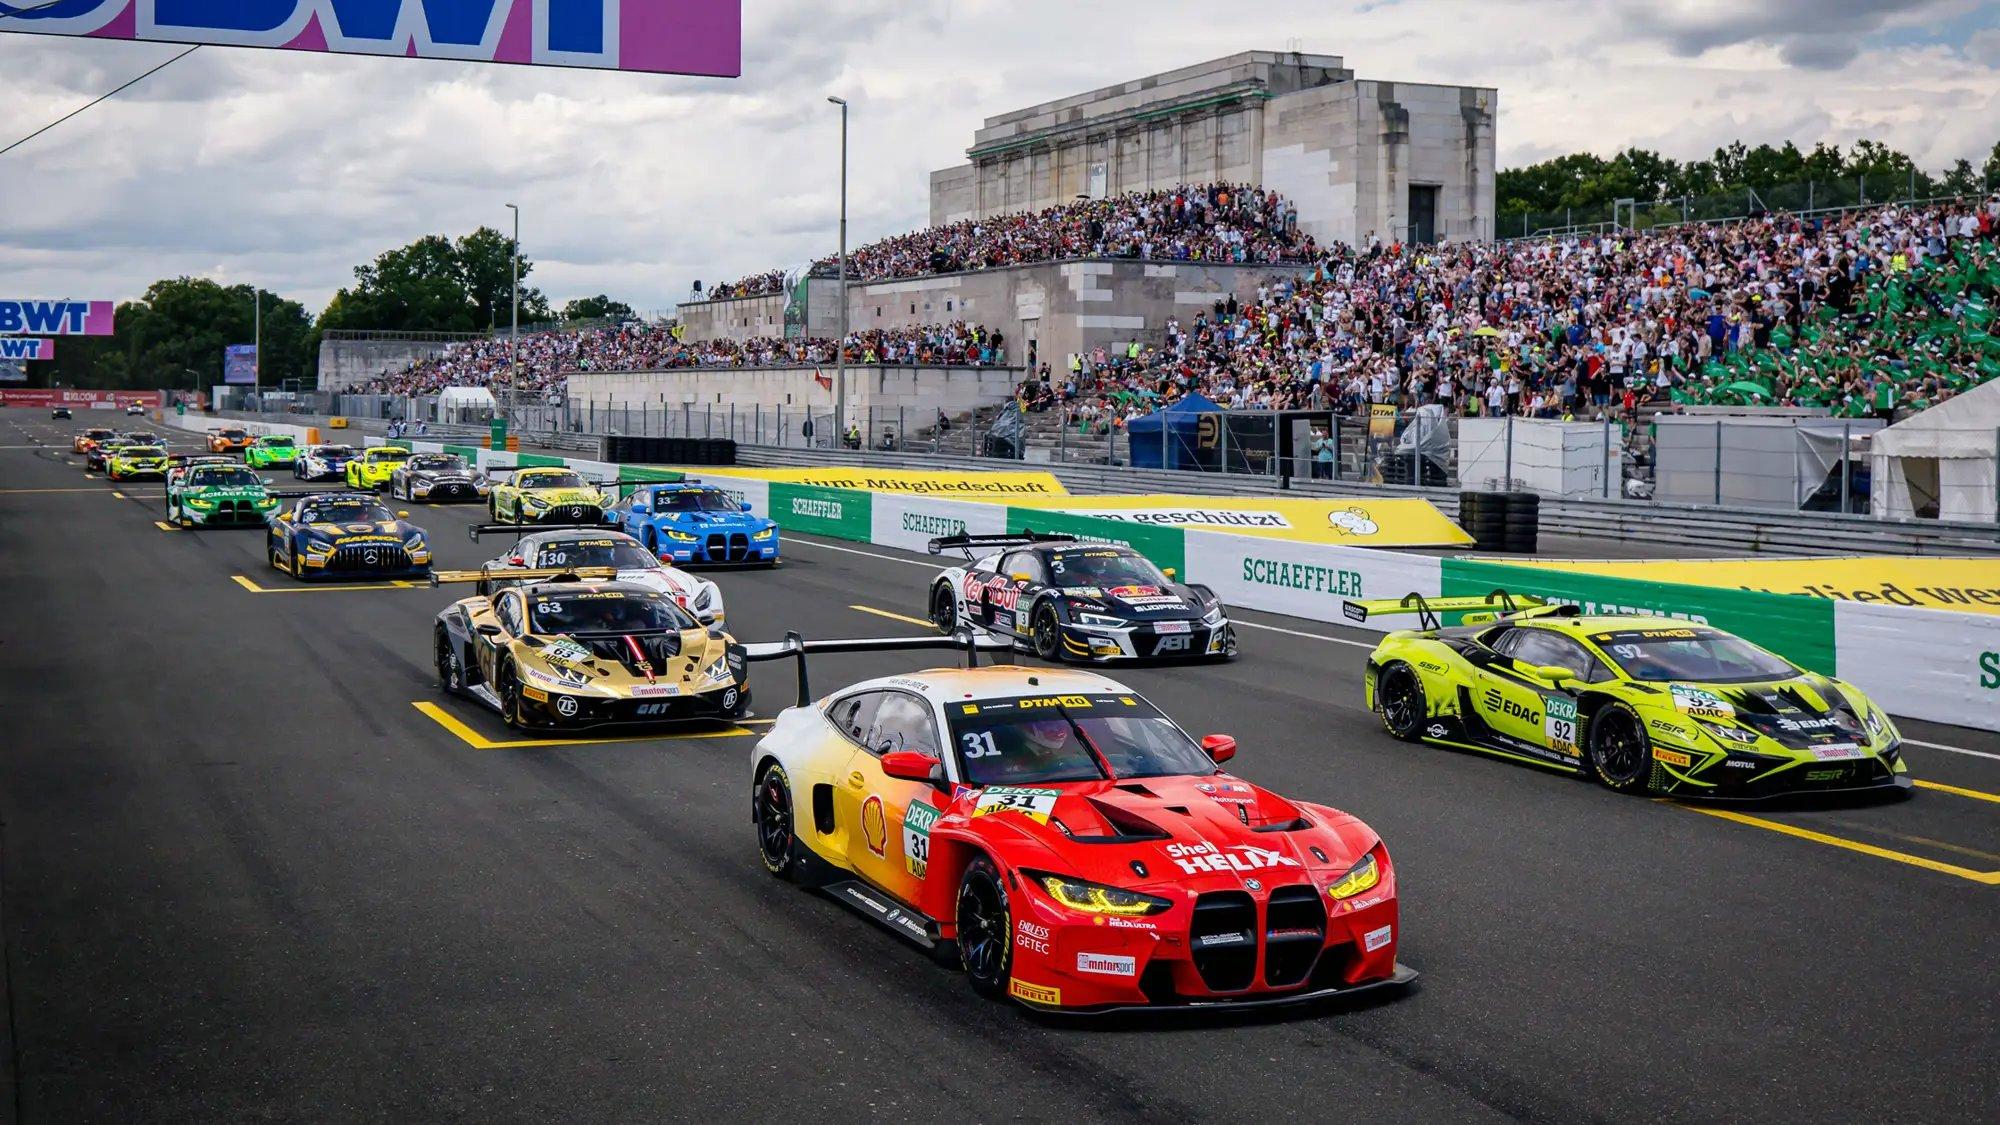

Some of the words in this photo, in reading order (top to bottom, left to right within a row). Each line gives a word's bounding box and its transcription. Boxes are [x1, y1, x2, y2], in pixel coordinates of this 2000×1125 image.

[0, 301, 87, 332] BWT
[0, 339, 40, 359] WT
[657, 496, 671, 505] 33
[792, 497, 842, 520] SCHAEFFLER
[903, 513, 966, 536] SCHAEFFLER
[1133, 511, 1287, 526] geschützt
[539, 552, 566, 567] 130
[1051, 561, 1065, 574] 3
[1243, 557, 1363, 597] SCHAEFFLER
[537, 602, 563, 614] 63
[553, 648, 575, 658] 63
[1152, 635, 1194, 656] ABT
[1613, 643, 1649, 659] 92
[541, 654, 569, 666] ADAC
[1418, 660, 1440, 672] SSR
[560, 699, 575, 711] ZF
[1503, 698, 1540, 726] EDAG
[1687, 707, 1724, 718] ADAC
[1554, 720, 1571, 741] 92
[1650, 719, 1686, 734] SSR
[1800, 717, 1841, 729] EDAG
[961, 730, 1002, 759] 31
[1552, 738, 1573, 755] ADAC
[1726, 760, 1756, 769] MOTUL
[1805, 769, 1843, 781] SSR
[986, 786, 1058, 796] DEKRA
[997, 794, 1037, 810] 31
[911, 833, 927, 861] 31
[1166, 841, 1219, 858] Shell
[1174, 845, 1300, 875] HELIX
[1018, 919, 1049, 938] ENDLESS
[1016, 934, 1050, 955] GETEC
[1089, 959, 1134, 975] motorsport
[1014, 983, 1056, 1003] PIRELLI
